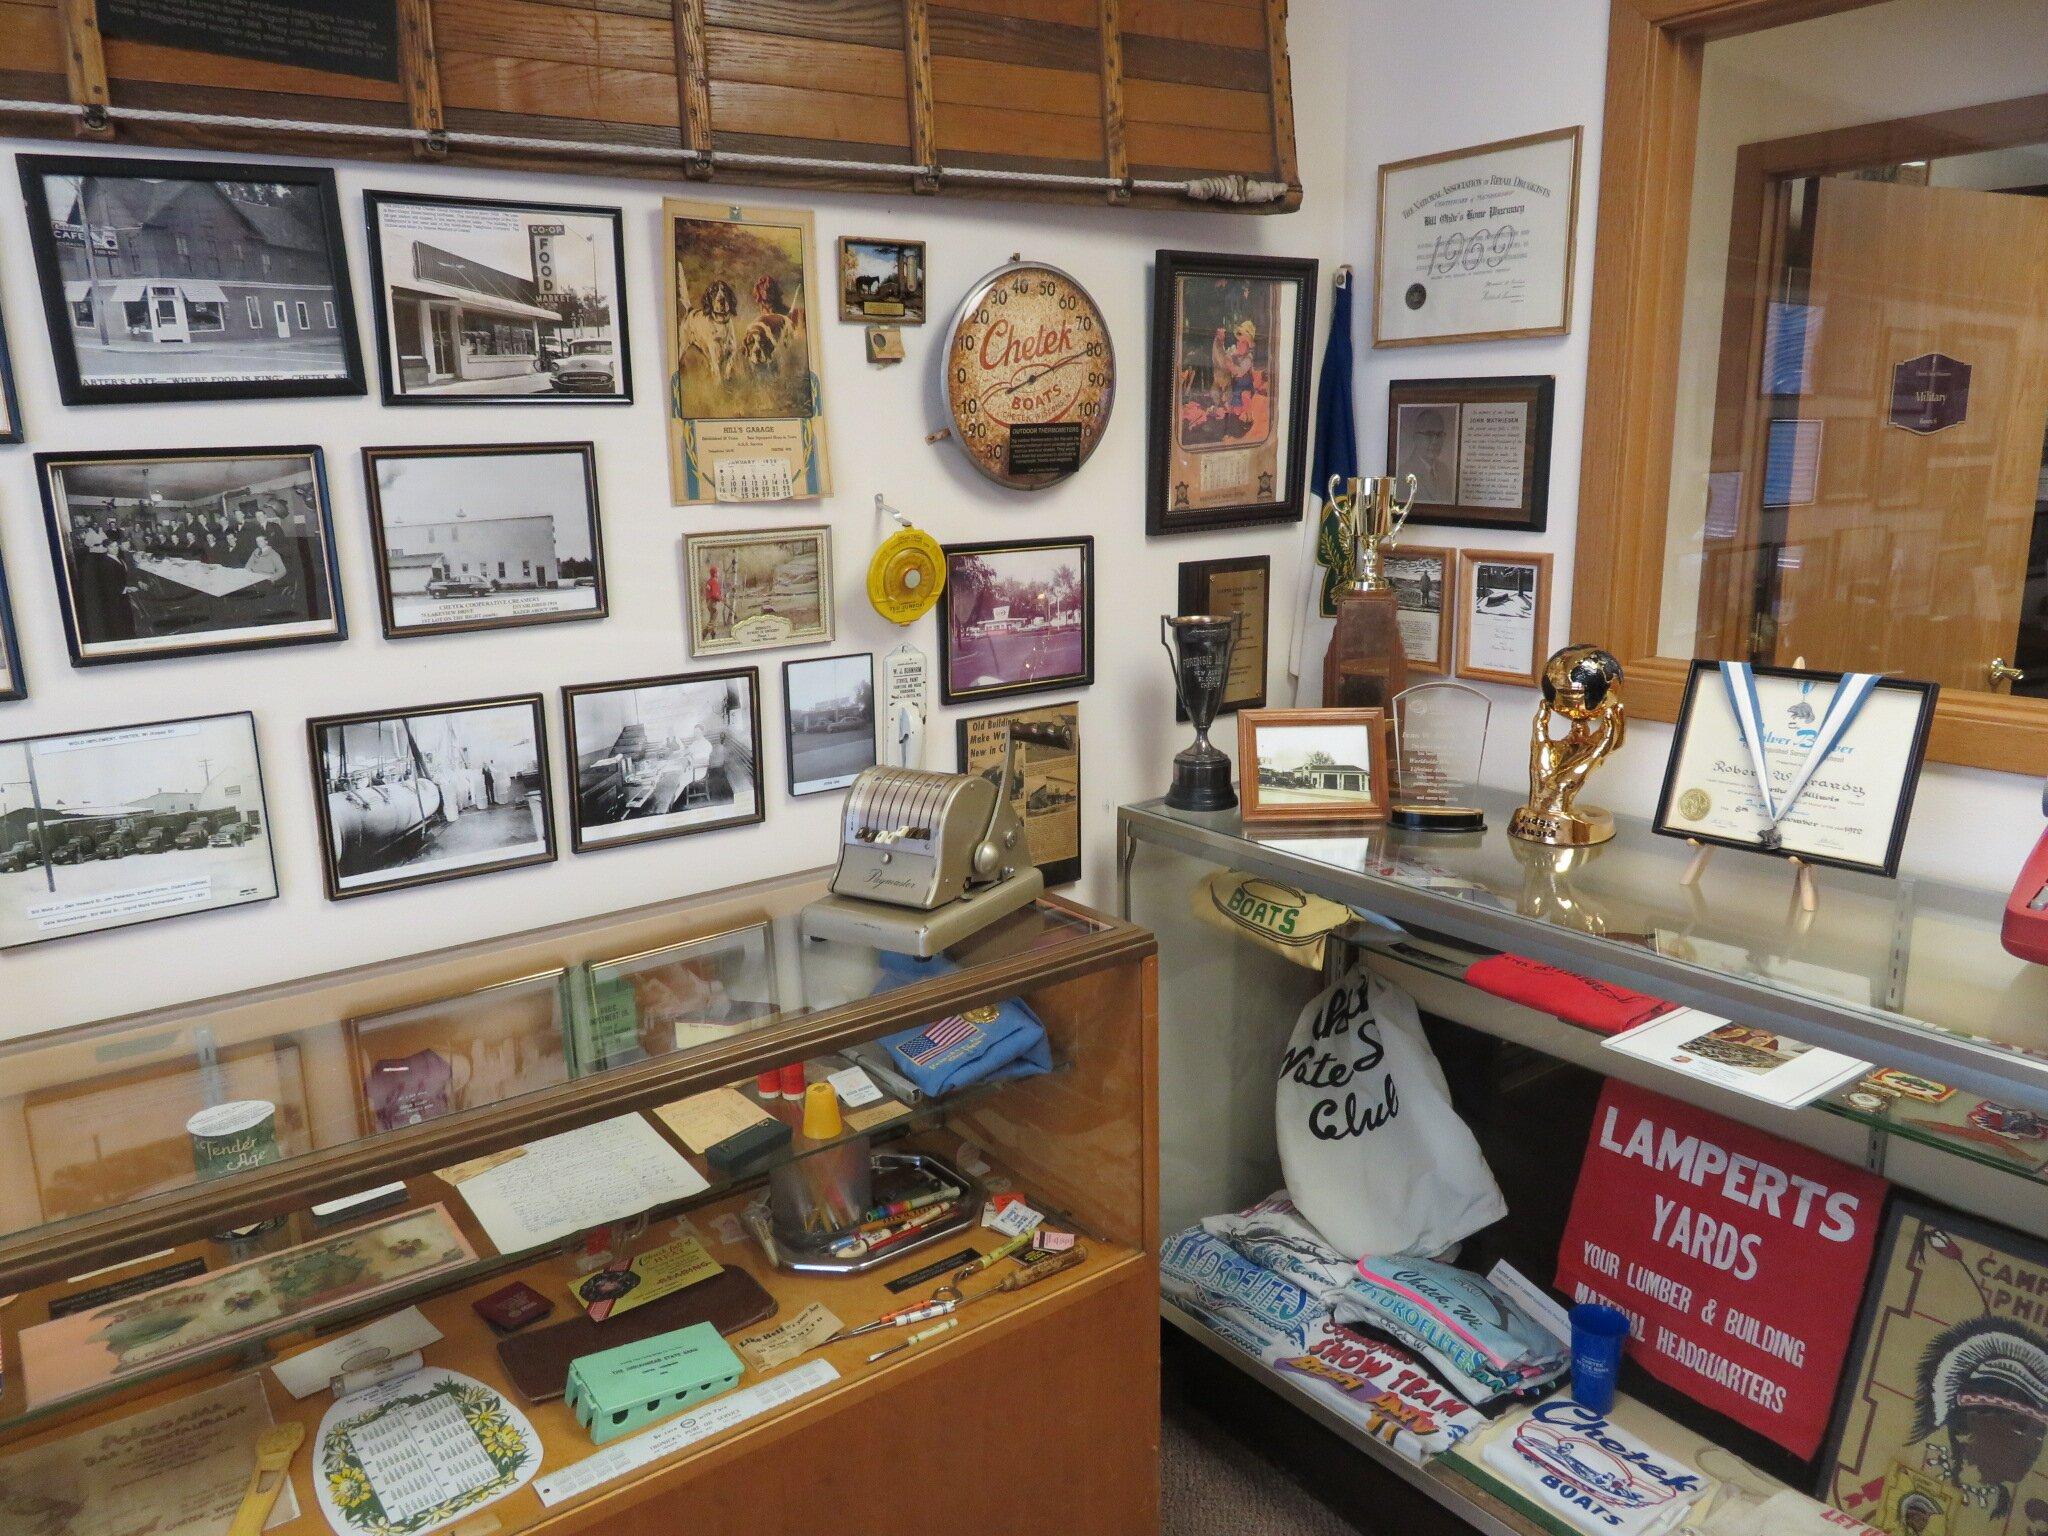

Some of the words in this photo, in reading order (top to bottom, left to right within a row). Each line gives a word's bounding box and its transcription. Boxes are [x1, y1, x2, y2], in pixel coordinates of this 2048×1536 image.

[53, 230, 85, 241] CAFE
[1012, 278, 1028, 295] 40
[1039, 281, 1056, 297] 50
[535, 294, 571, 303] MARKET
[990, 290, 1007, 306] 30
[1058, 296, 1076, 311] 60
[972, 309, 989, 325] 20
[1075, 315, 1092, 332] 70
[979, 318, 1073, 370] Chetek
[1086, 342, 1101, 357] 80
[1088, 372, 1105, 388] 90
[1011, 383, 1062, 411] BOATS
[1916, 390, 1946, 406] Military
[1078, 401, 1100, 417] 100
[973, 721, 985, 731] Old
[970, 734, 990, 744] Make
[994, 731, 1006, 740] Wa
[1794, 728, 1855, 756] Bver
[971, 748, 986, 757] New
[990, 747, 996, 755] in
[1712, 760, 1757, 778] Rober
[864, 868, 916, 890] Paymaster
[1227, 887, 1299, 935] BOATS
[1309, 1073, 1399, 1140] Club
[201, 1136, 258, 1161] Tender
[227, 1150, 266, 1171] Age
[1600, 1105, 1860, 1242] LAMPERTS
[1652, 1194, 1763, 1281] YARDS
[1392, 1270, 1451, 1313] Chetek,
[1583, 1241, 1621, 1279] YOUR
[1627, 1262, 1693, 1314] LUMBER
[1700, 1298, 1718, 1326] &
[1723, 1308, 1806, 1369] BUILDING
[1574, 1282, 1646, 1342] MATIAL
[1655, 1326, 1787, 1415] HEADQUARTERS
[1308, 1338, 1393, 1379] SHOW
[1387, 1369, 1470, 1418] TEAM
[1532, 1401, 1700, 1493] Chetek
[1541, 1475, 1625, 1527] BOATS
